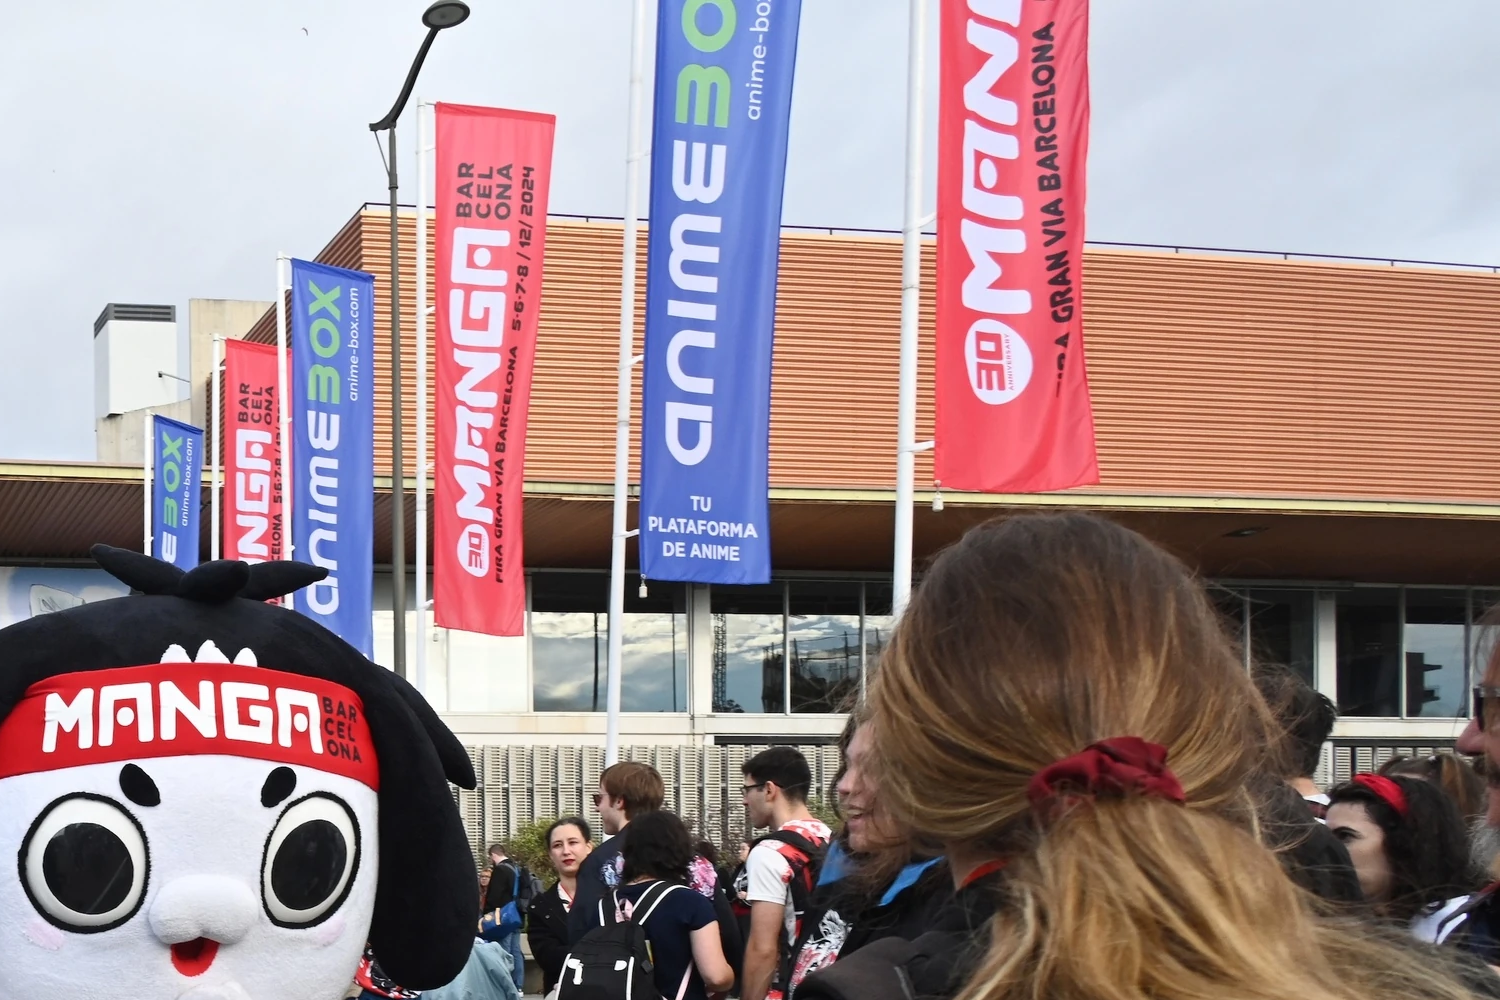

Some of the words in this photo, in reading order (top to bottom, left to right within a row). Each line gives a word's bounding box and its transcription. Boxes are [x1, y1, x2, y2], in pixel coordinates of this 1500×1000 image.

[1031, 20, 1061, 191] BARCELONA
[456, 162, 474, 217] BAR
[475, 166, 493, 218] CEL
[494, 163, 512, 219] ONA
[521, 166, 534, 216] 2024
[1040, 197, 1066, 247] VIA
[1044, 249, 1073, 323] GRAN
[347, 287, 358, 401] anime-box.com
[975, 330, 1006, 391] 30
[1003, 333, 1014, 390] ANNIVERSARY
[449, 226, 510, 524] MANGA
[495, 345, 518, 453] BARCELONA
[238, 382, 249, 422] BAR
[250, 386, 262, 423] CEL
[264, 385, 273, 425] ONA
[181, 437, 192, 526] anime-box.com
[495, 458, 504, 487] VIA
[495, 492, 503, 538] GRAN
[648, 516, 758, 538] PLATAFORMA
[690, 495, 711, 511] TU
[467, 530, 483, 569] 30
[495, 544, 503, 582] FIRA
[662, 541, 686, 557] DE
[689, 542, 740, 561] ANIME
[41, 679, 324, 754] MANGA
[322, 696, 357, 722] BAR
[324, 717, 356, 742] CEL
[326, 737, 362, 763] ONA
